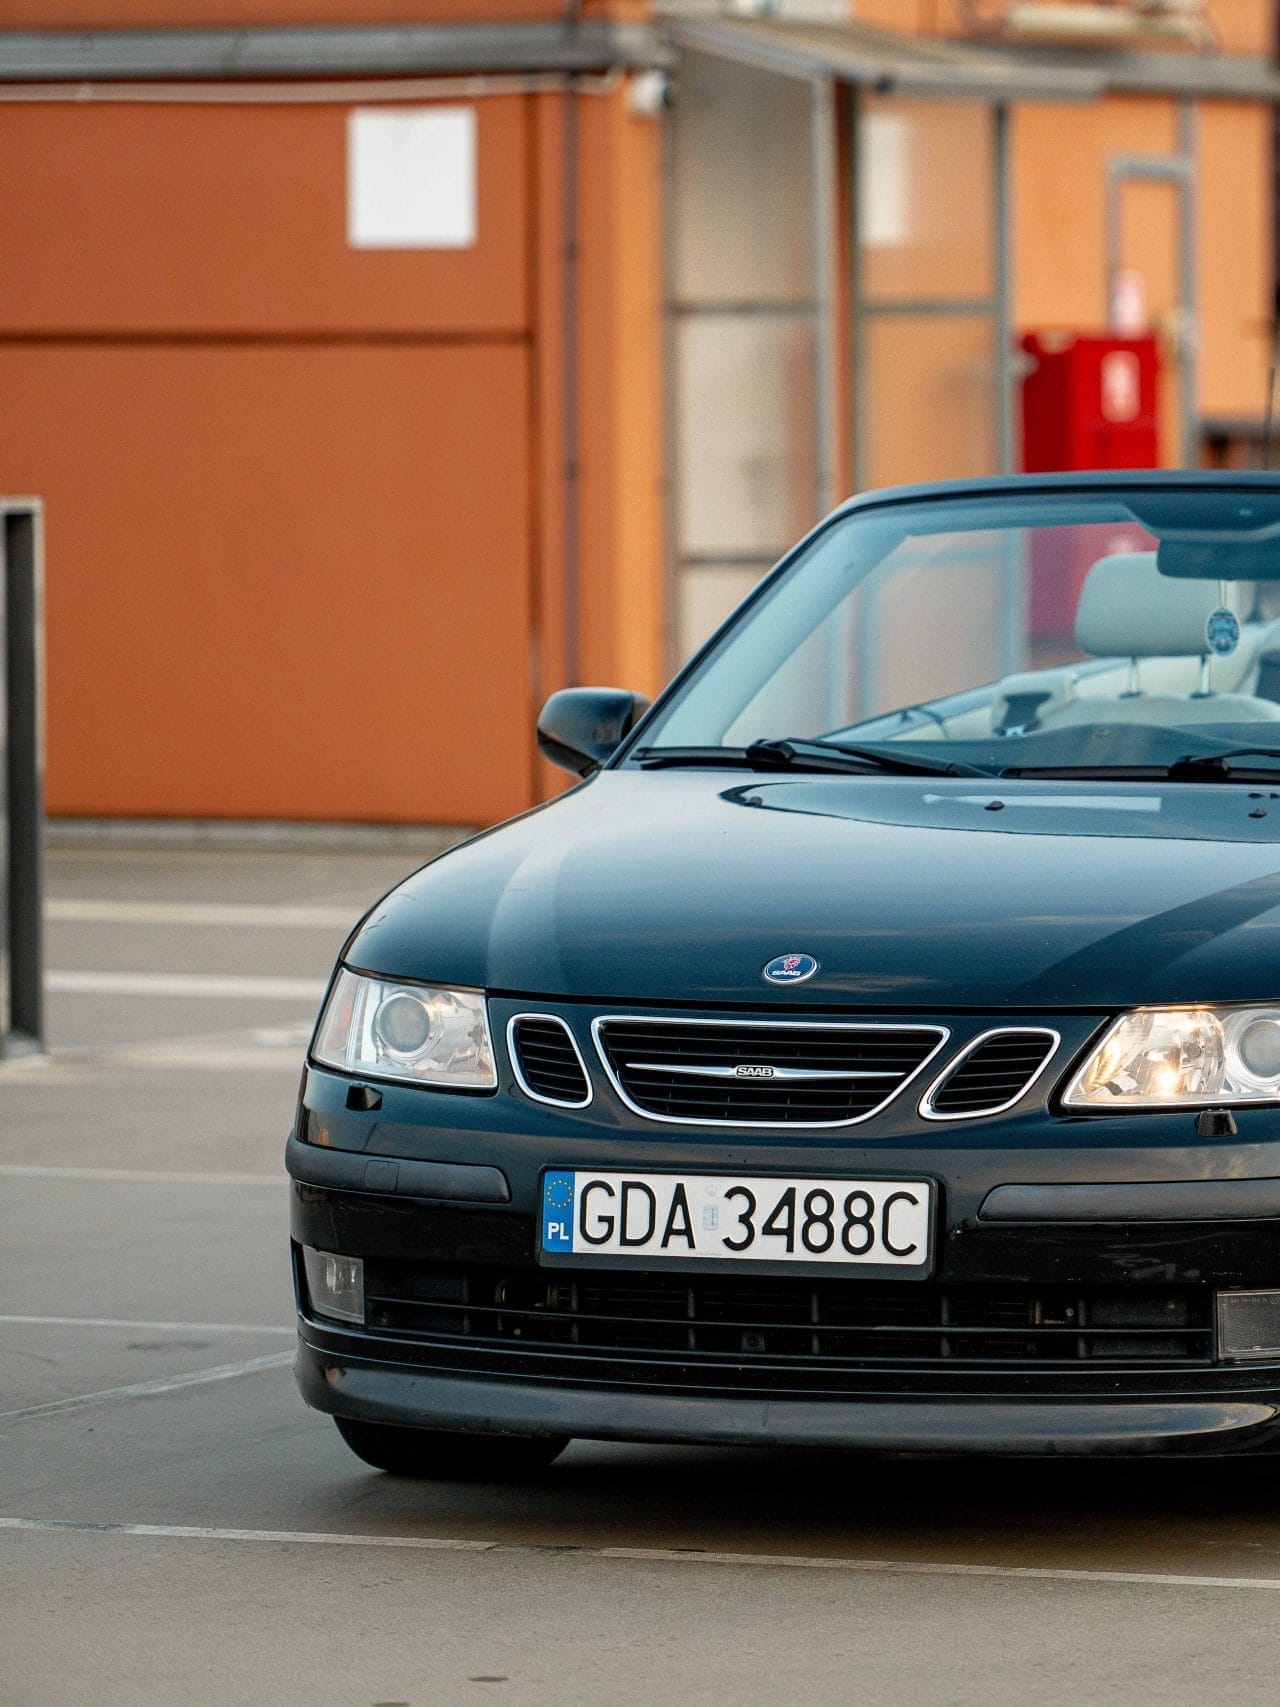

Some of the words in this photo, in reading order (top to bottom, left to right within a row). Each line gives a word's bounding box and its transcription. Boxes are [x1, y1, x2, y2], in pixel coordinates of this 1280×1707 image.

[737, 1067, 773, 1077] SAAB
[579, 1179, 697, 1250] GDA
[721, 1184, 920, 1257] 3488C
[547, 1222, 570, 1240] PL
